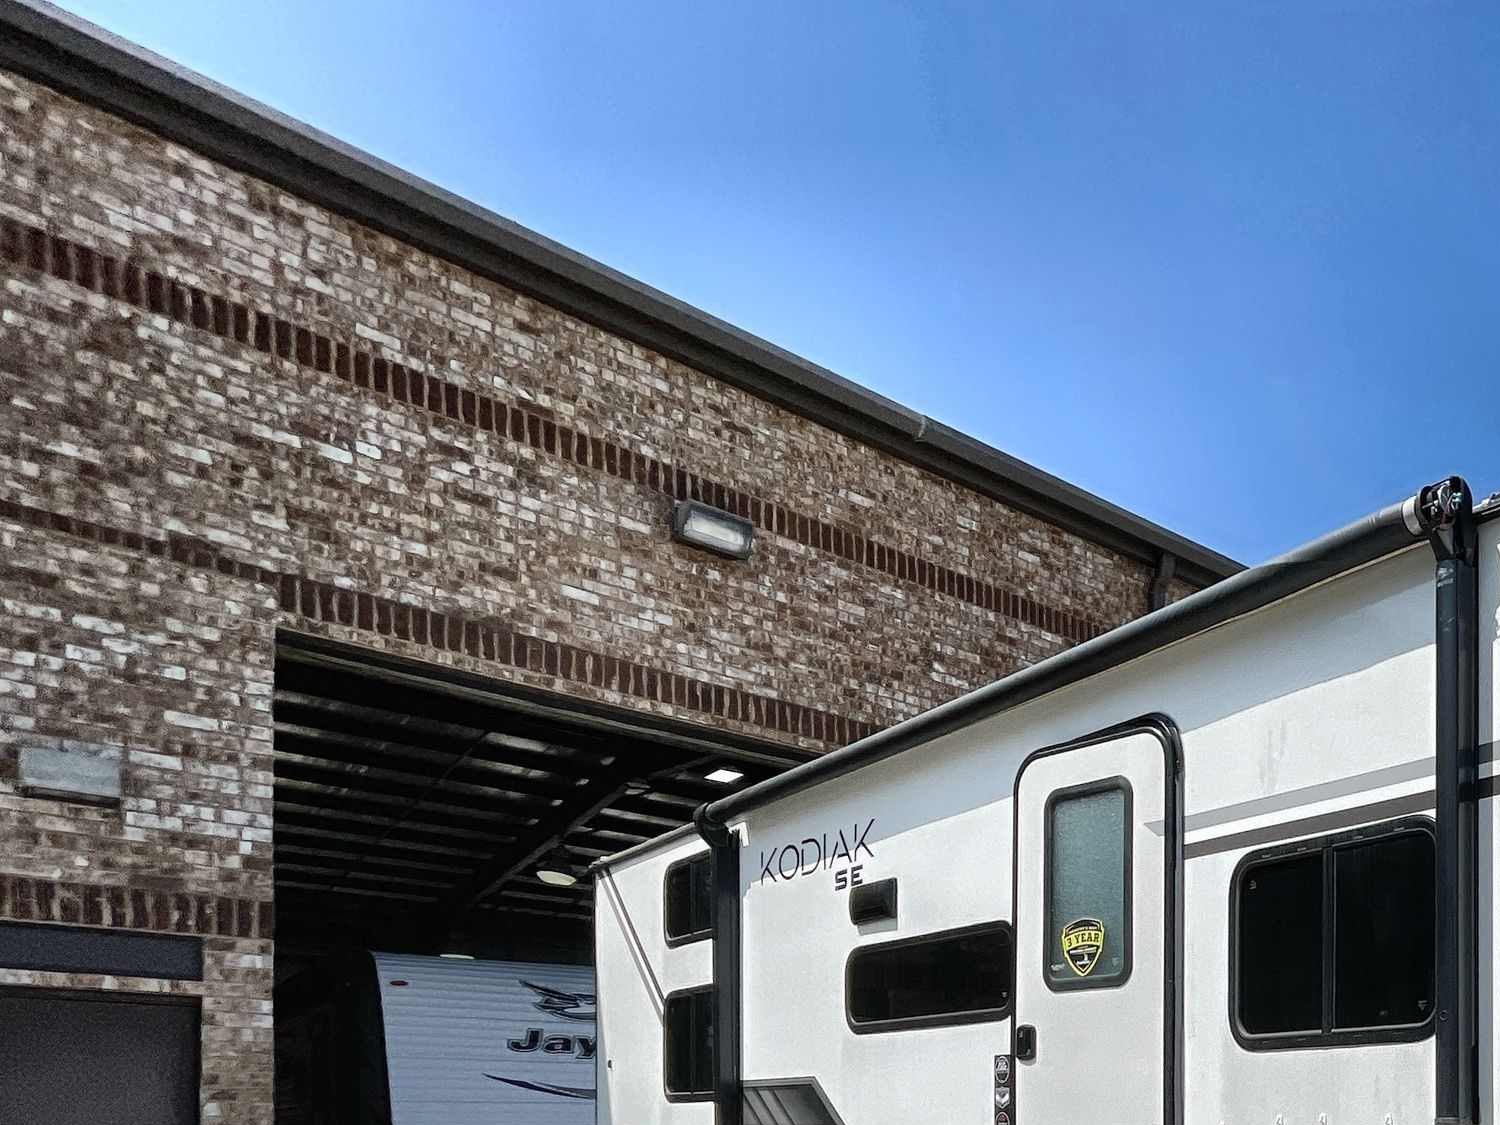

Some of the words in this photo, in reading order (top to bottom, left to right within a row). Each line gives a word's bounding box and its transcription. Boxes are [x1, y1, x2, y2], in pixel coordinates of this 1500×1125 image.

[760, 819, 876, 886] KODIAK
[834, 864, 864, 892] SE
[1074, 932, 1100, 944] YEAR
